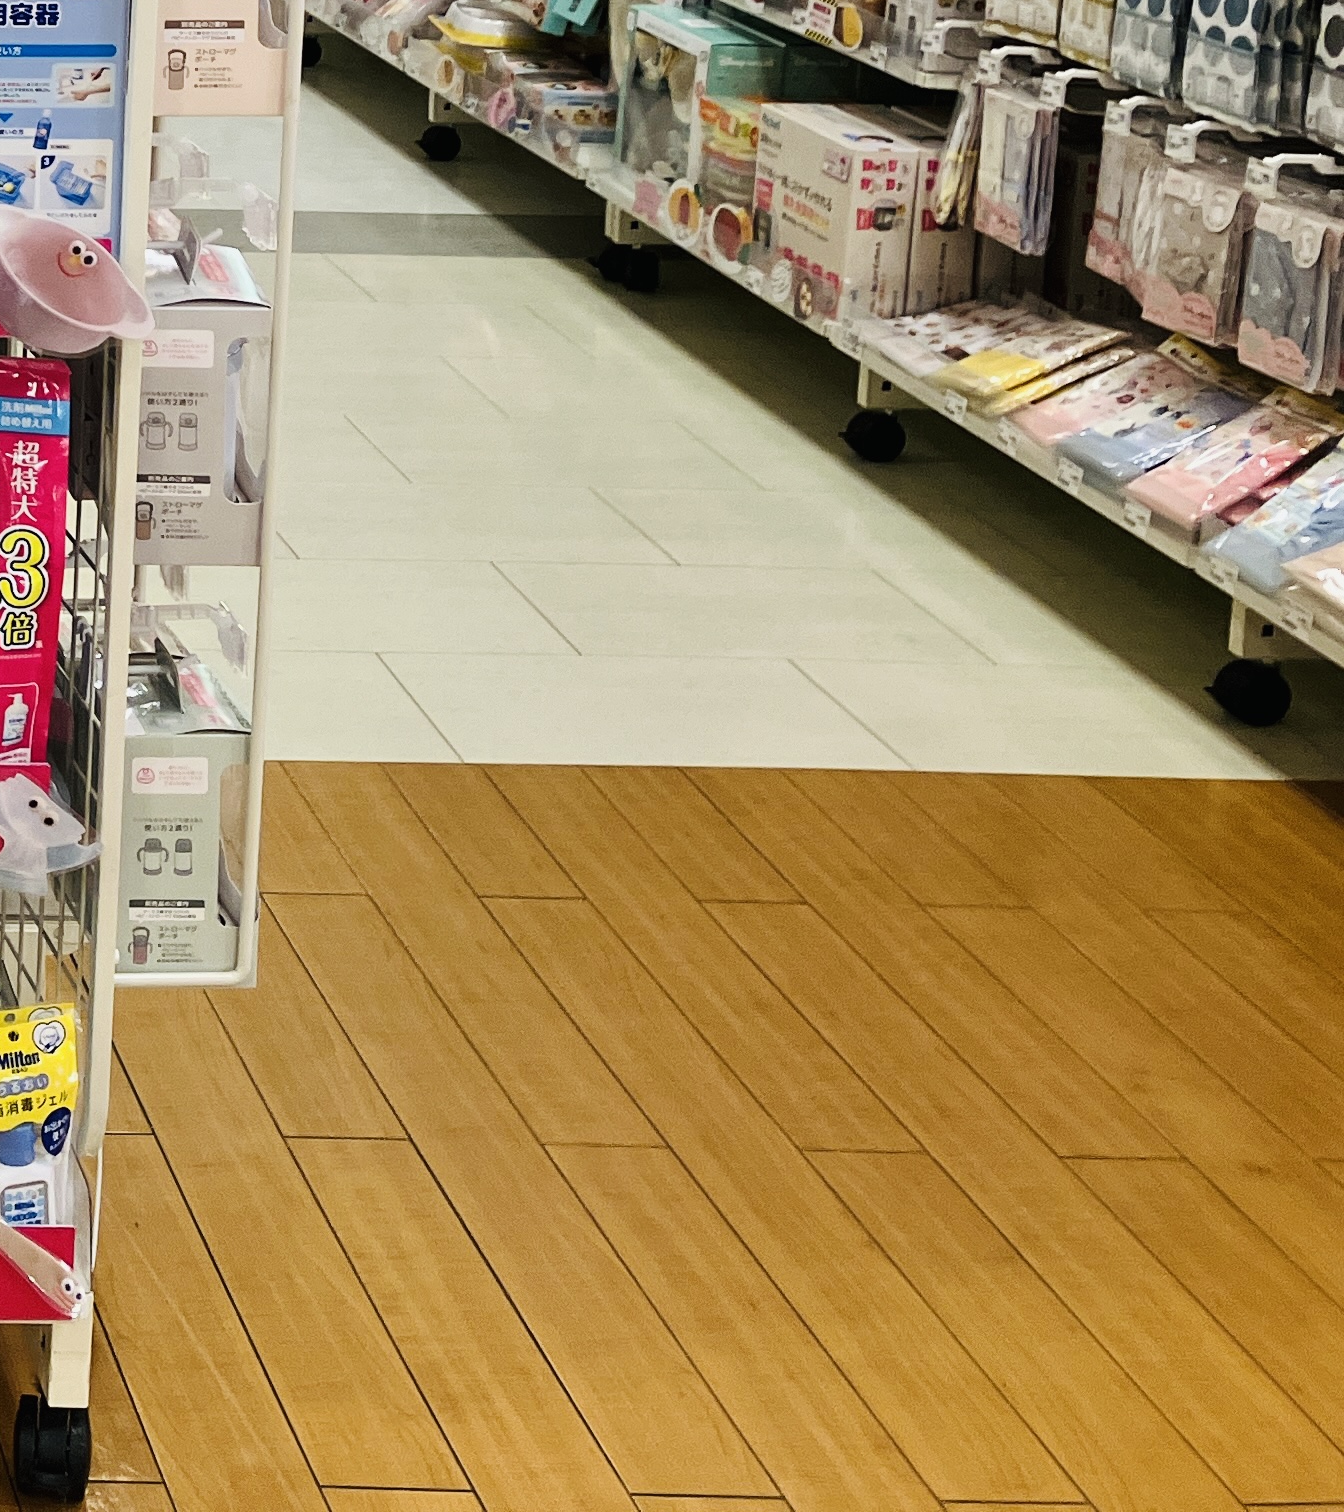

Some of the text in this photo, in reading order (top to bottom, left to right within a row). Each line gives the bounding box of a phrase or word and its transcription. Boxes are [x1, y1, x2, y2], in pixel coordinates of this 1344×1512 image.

[11, 440, 38, 523] 超特大
[1, 612, 37, 650] 倍
